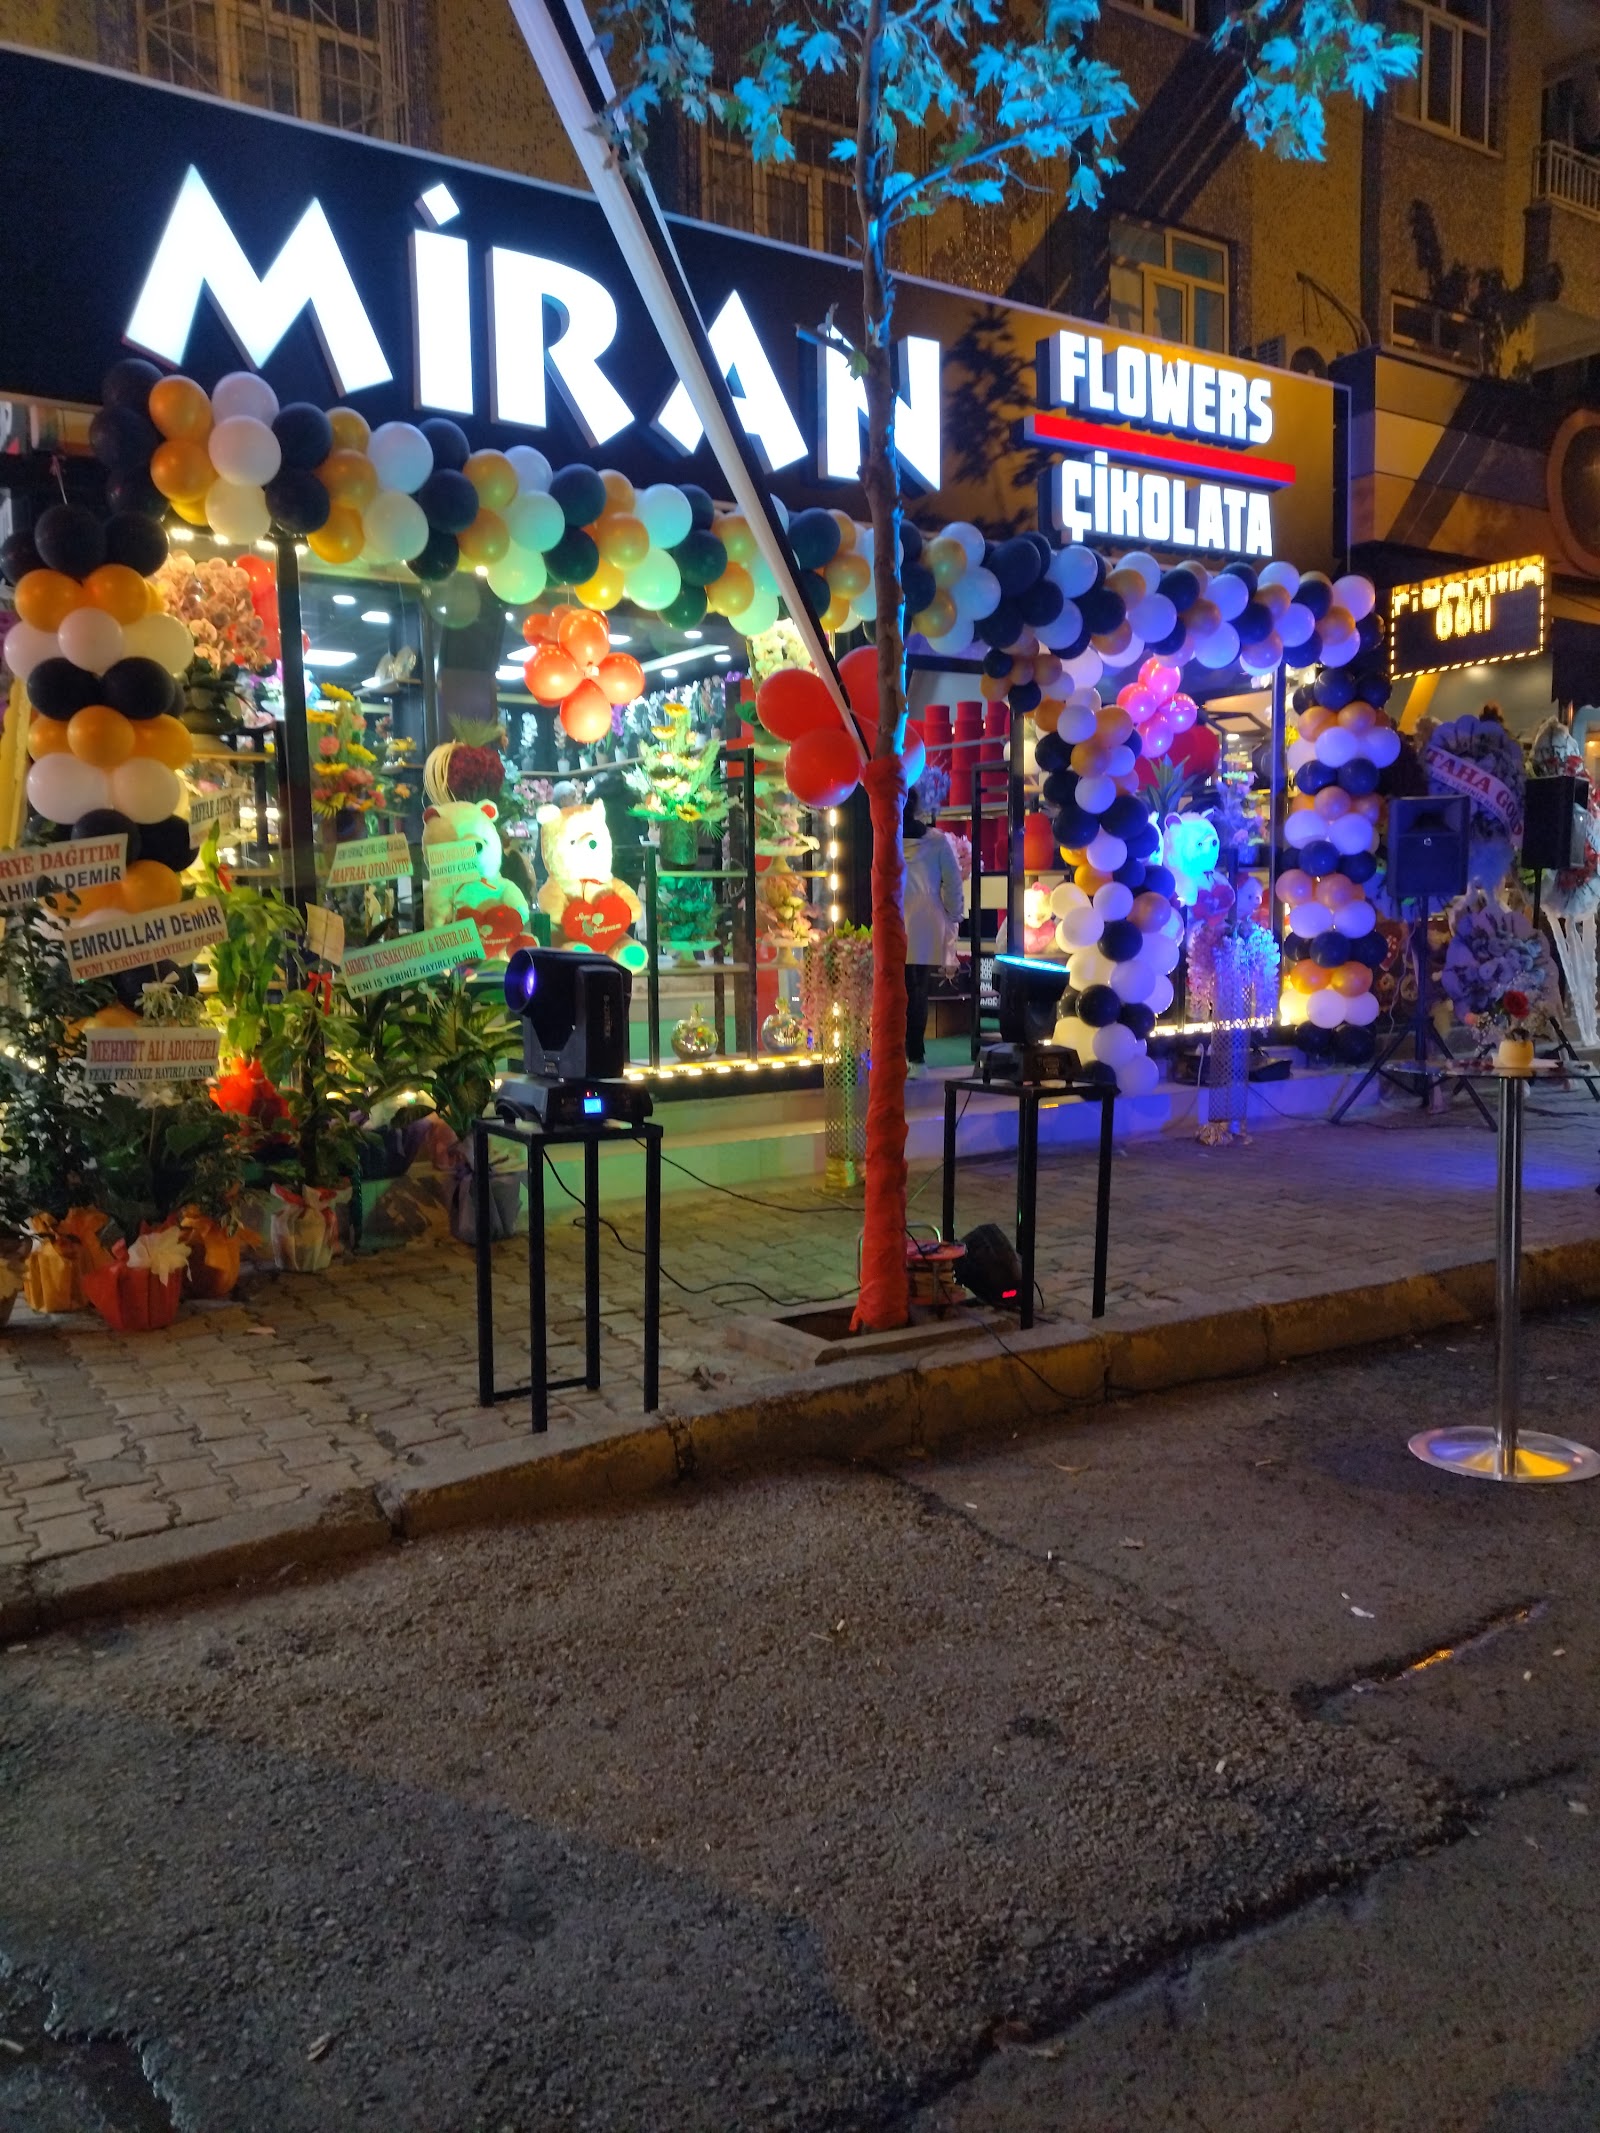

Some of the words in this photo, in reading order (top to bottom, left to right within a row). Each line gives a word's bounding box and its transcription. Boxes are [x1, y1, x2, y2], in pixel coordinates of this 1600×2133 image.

[124, 164, 941, 493] MİRAN
[1056, 329, 1273, 445] FLOWERS
[1058, 450, 1273, 557] ÇİKOLATA
[1426, 748, 1492, 795] TAHA
[1495, 789, 1523, 836] GOLD
[40, 843, 121, 870] DAĞITIM
[65, 863, 122, 889] DEMİR
[69, 917, 167, 961] EMRULLAH
[194, 930, 225, 950] OLSUN
[345, 954, 373, 977] AHMET
[427, 939, 435, 953] &
[434, 930, 460, 950] ENVER
[460, 927, 474, 945] DAL
[420, 960, 451, 975] HAYIRLI
[91, 1039, 145, 1062] MEHMET
[188, 1064, 215, 1077] OLSUN
